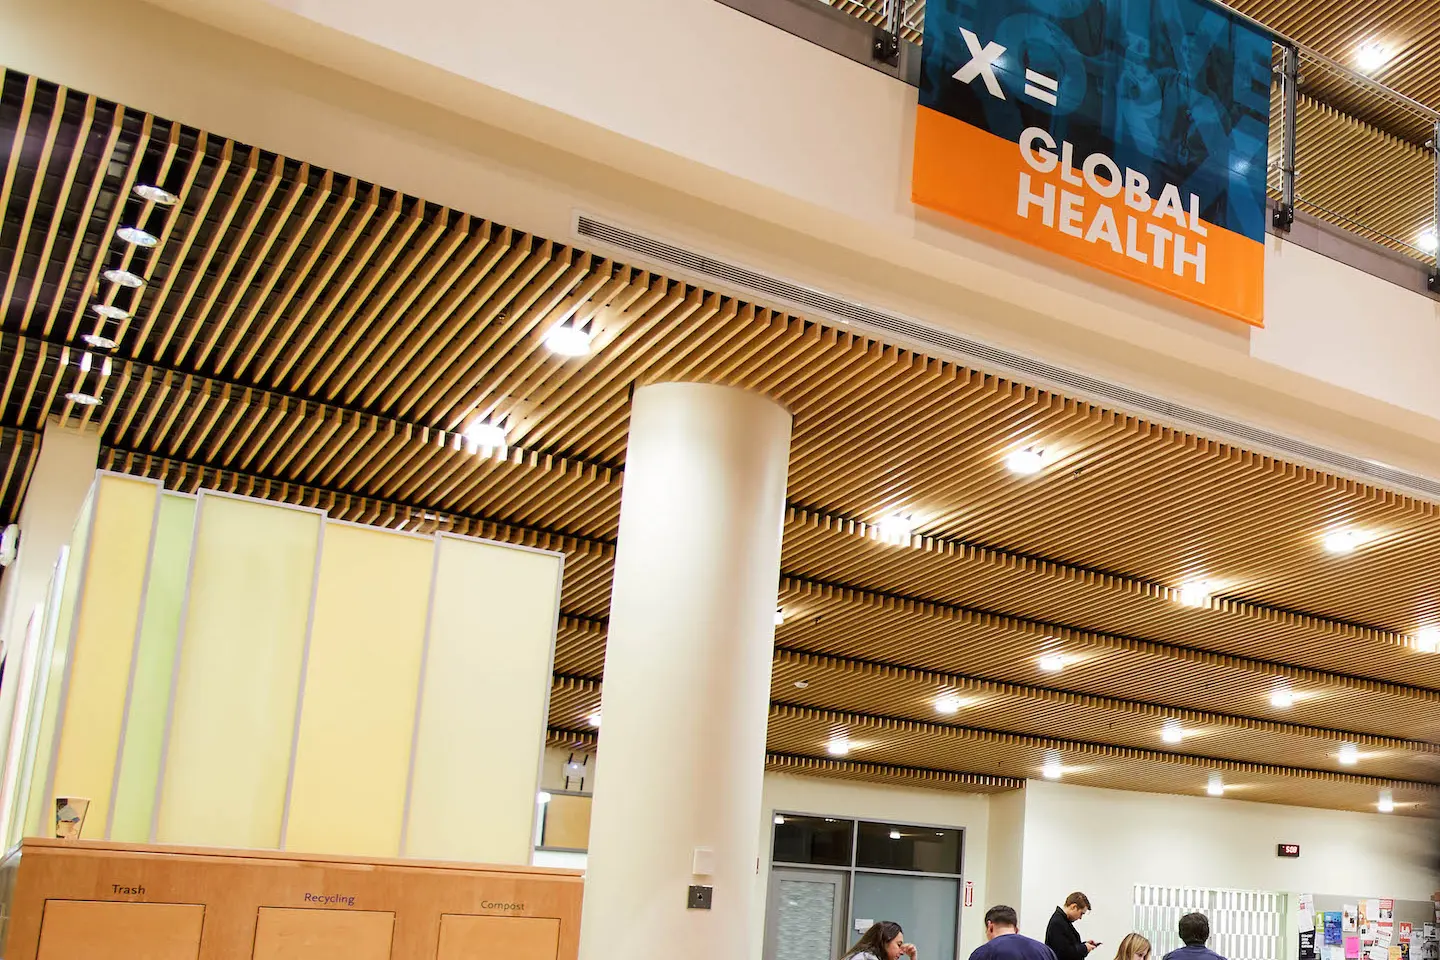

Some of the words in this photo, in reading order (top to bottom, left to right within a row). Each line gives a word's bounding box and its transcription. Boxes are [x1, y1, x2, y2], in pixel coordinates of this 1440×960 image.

[952, 26, 1007, 100] X
[1018, 126, 1208, 239] GLOBAL
[1016, 172, 1207, 285] HEALTH
[112, 884, 146, 895] Trash
[304, 892, 355, 906] Recycling
[480, 900, 525, 911] Compost
